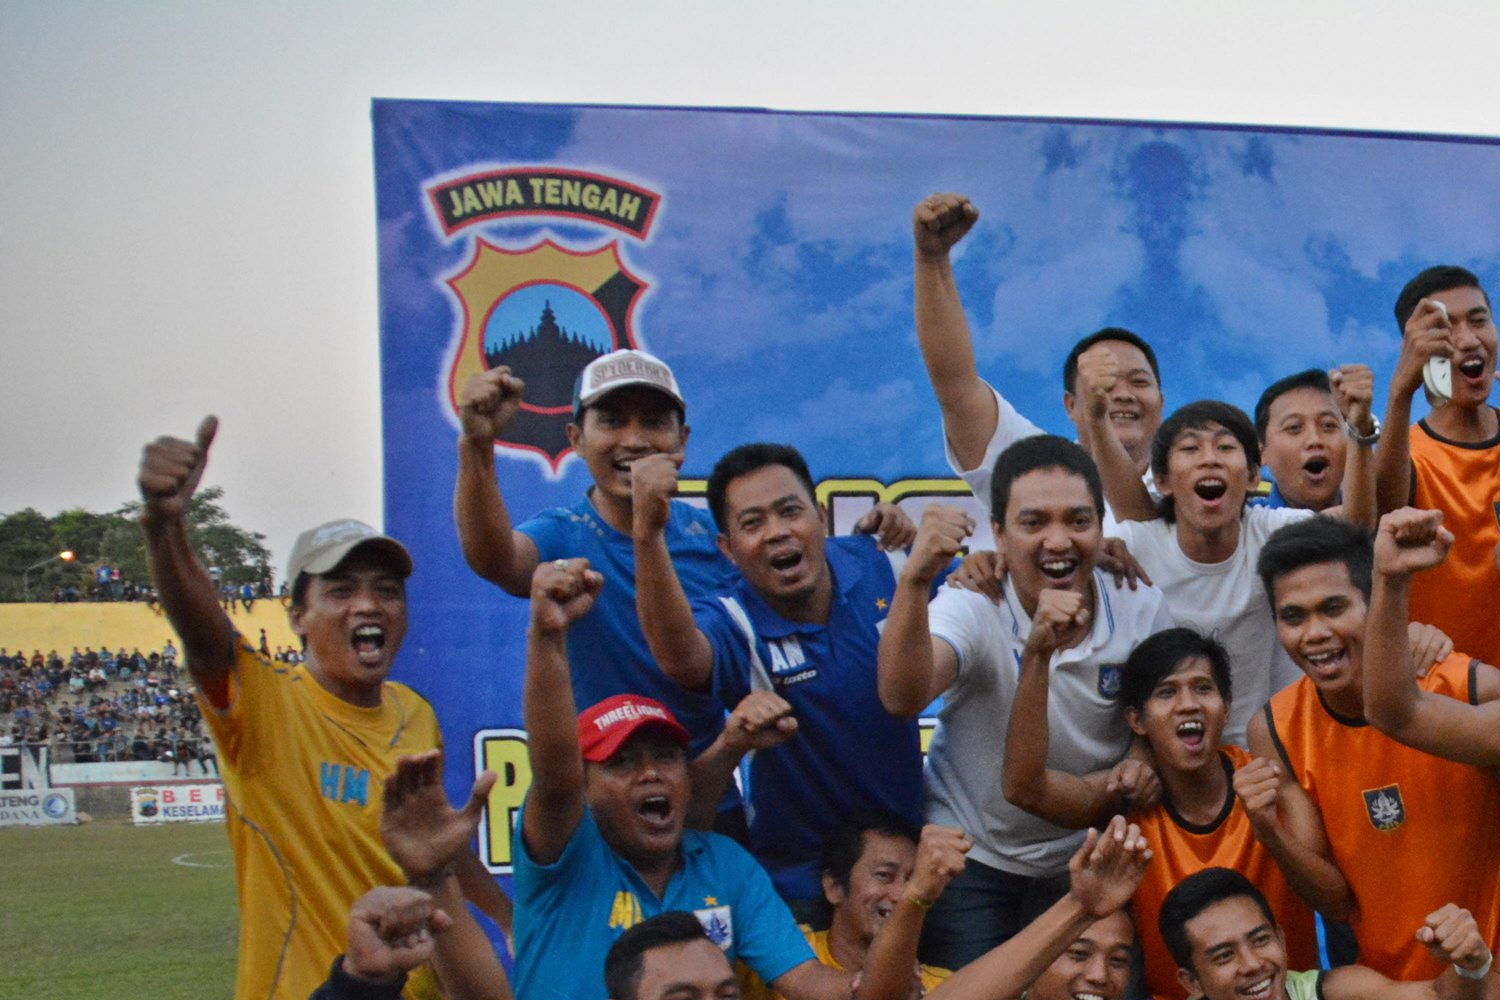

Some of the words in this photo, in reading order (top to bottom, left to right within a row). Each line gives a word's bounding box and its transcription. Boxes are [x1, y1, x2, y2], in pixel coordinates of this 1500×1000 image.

[450, 178, 525, 218] JAWA
[529, 177, 641, 222] TENGAH
[768, 636, 806, 673] AN
[784, 669, 817, 685] lotto
[321, 761, 369, 806] HM
